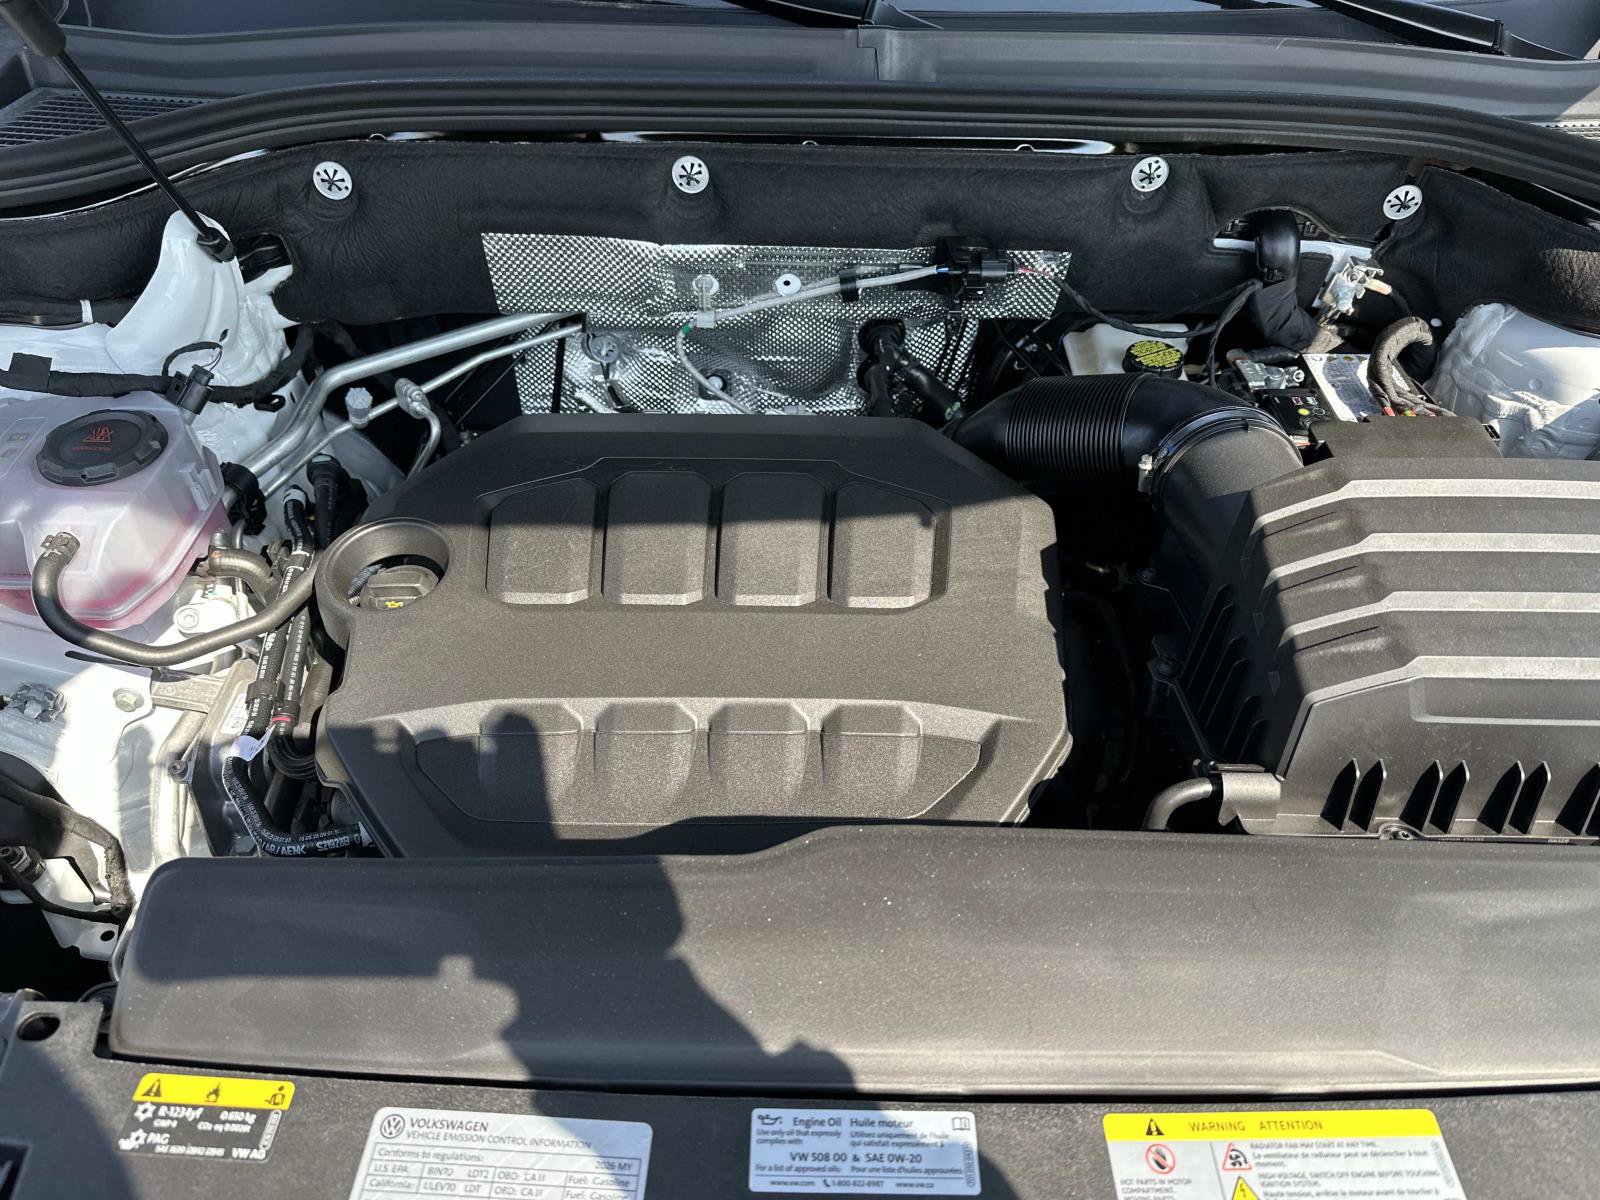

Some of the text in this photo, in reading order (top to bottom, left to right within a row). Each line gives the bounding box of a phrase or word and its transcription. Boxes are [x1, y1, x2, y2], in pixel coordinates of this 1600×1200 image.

[410, 1117, 489, 1132] VOLKSWAGEN
[793, 1117, 842, 1129] Engine Oil
[850, 1118, 913, 1129] Huile moteur
[1189, 1120, 1323, 1132] WARNING ATTENTION
[146, 1132, 171, 1145] PAG
[406, 1131, 592, 1149] VEHICLE EMISSION CONTROL INFORMATION
[231, 1147, 251, 1159] VW
[378, 1147, 420, 1159] Conforms
[421, 1149, 432, 1159] to
[790, 1151, 923, 1164] VW 508 00 & SAE 0W-20
[617, 1163, 633, 1171] MY
[592, 1175, 631, 1188] Gasoline
